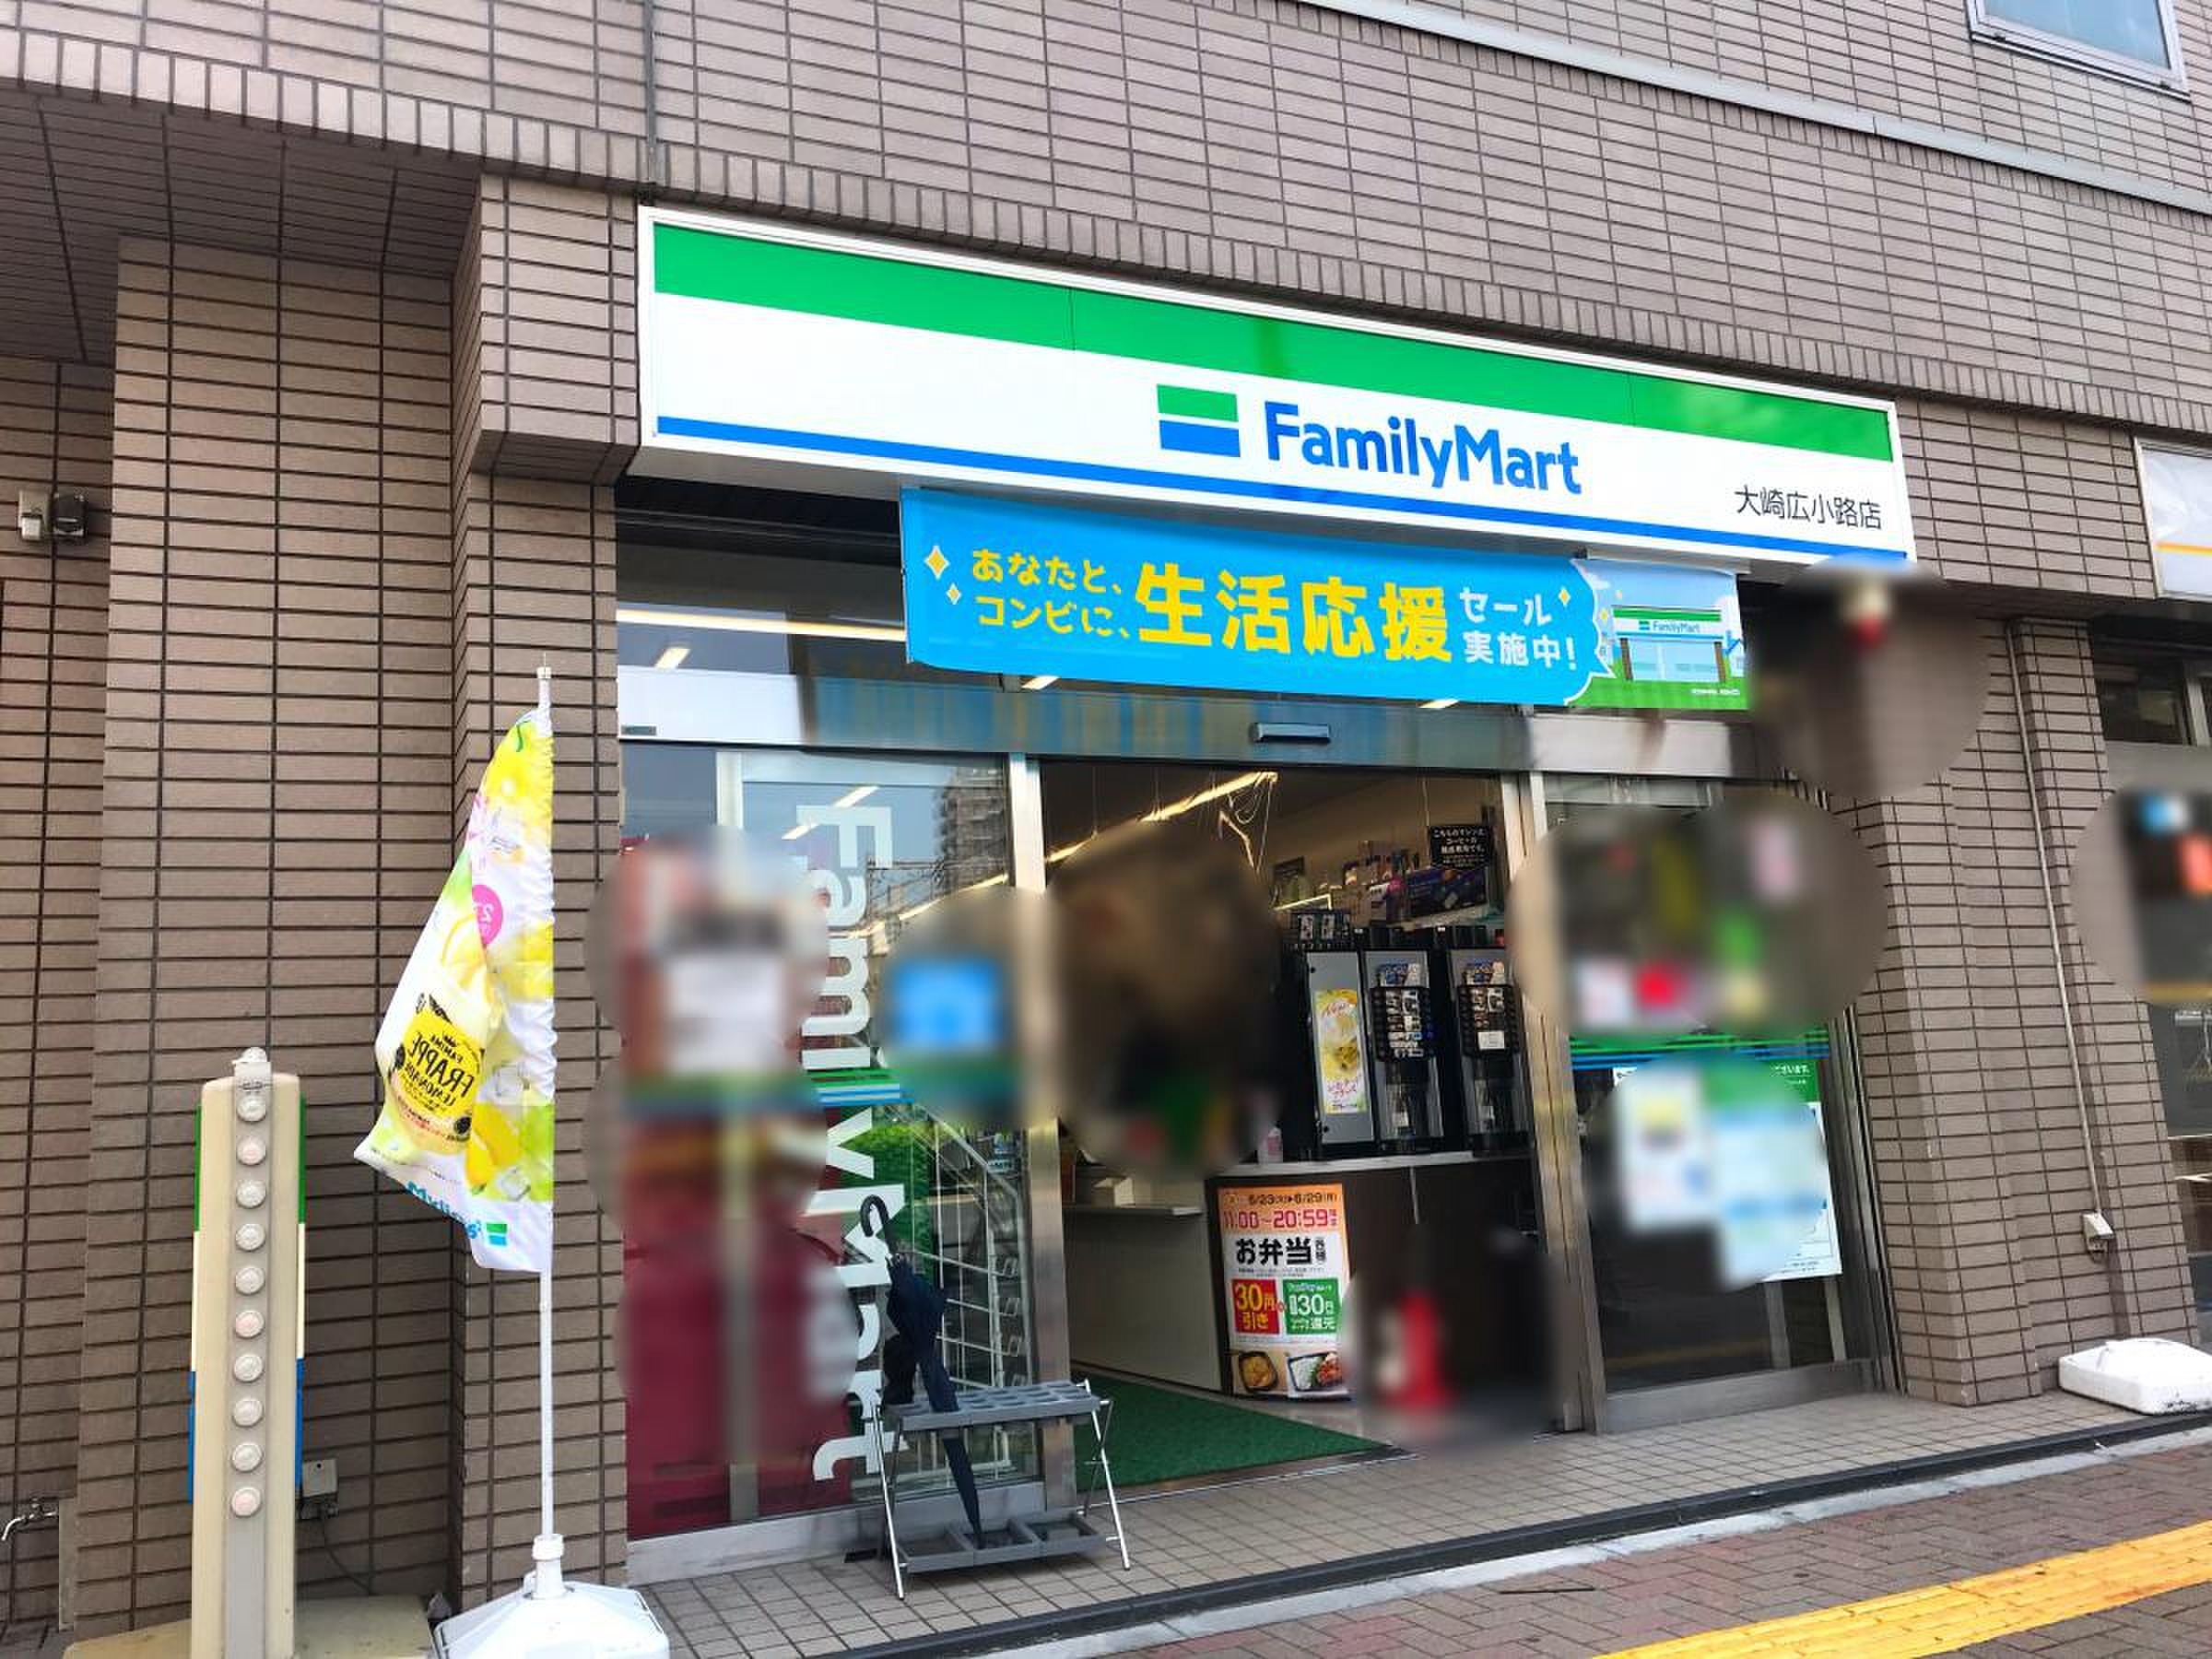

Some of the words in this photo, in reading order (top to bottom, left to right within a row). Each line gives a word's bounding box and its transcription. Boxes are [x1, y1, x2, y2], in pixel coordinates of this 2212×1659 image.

[1264, 400, 1583, 495] FamilyMart
[1734, 484, 1882, 530] 大崎広小路店
[972, 548, 1122, 594] あなたと、
[975, 596, 1131, 638] コンビに、
[1135, 562, 1452, 662] 生活応援
[1459, 587, 1552, 627] セール
[1463, 630, 1577, 670] 実施中!
[1235, 1237, 1312, 1265] お弁当
[1235, 1283, 1277, 1312] 30円
[1241, 1312, 1269, 1330] 引き
